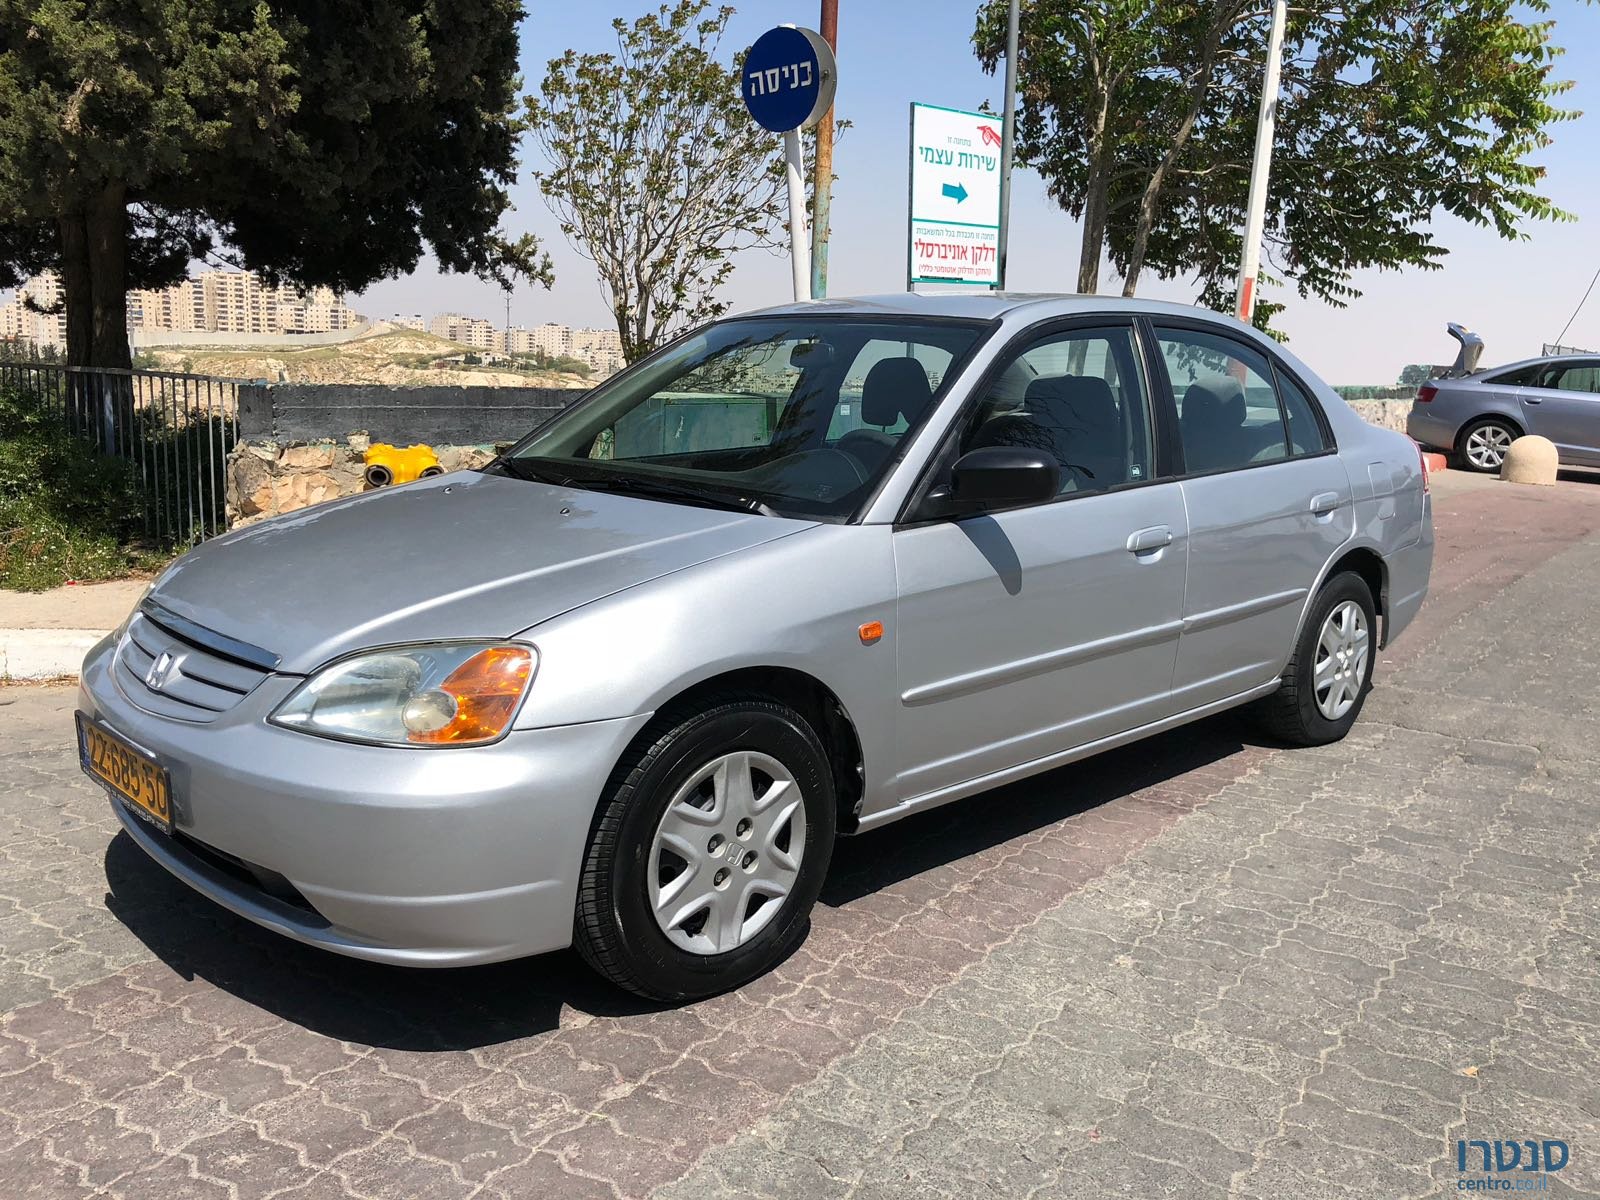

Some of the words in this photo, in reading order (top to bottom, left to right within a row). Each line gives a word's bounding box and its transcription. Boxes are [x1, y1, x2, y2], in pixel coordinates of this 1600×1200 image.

[750, 61, 812, 96] כניסה
[919, 146, 953, 166] עצמי
[957, 151, 996, 171] שירות
[914, 238, 968, 261] אוניברסלי
[971, 243, 996, 265] דלקן
